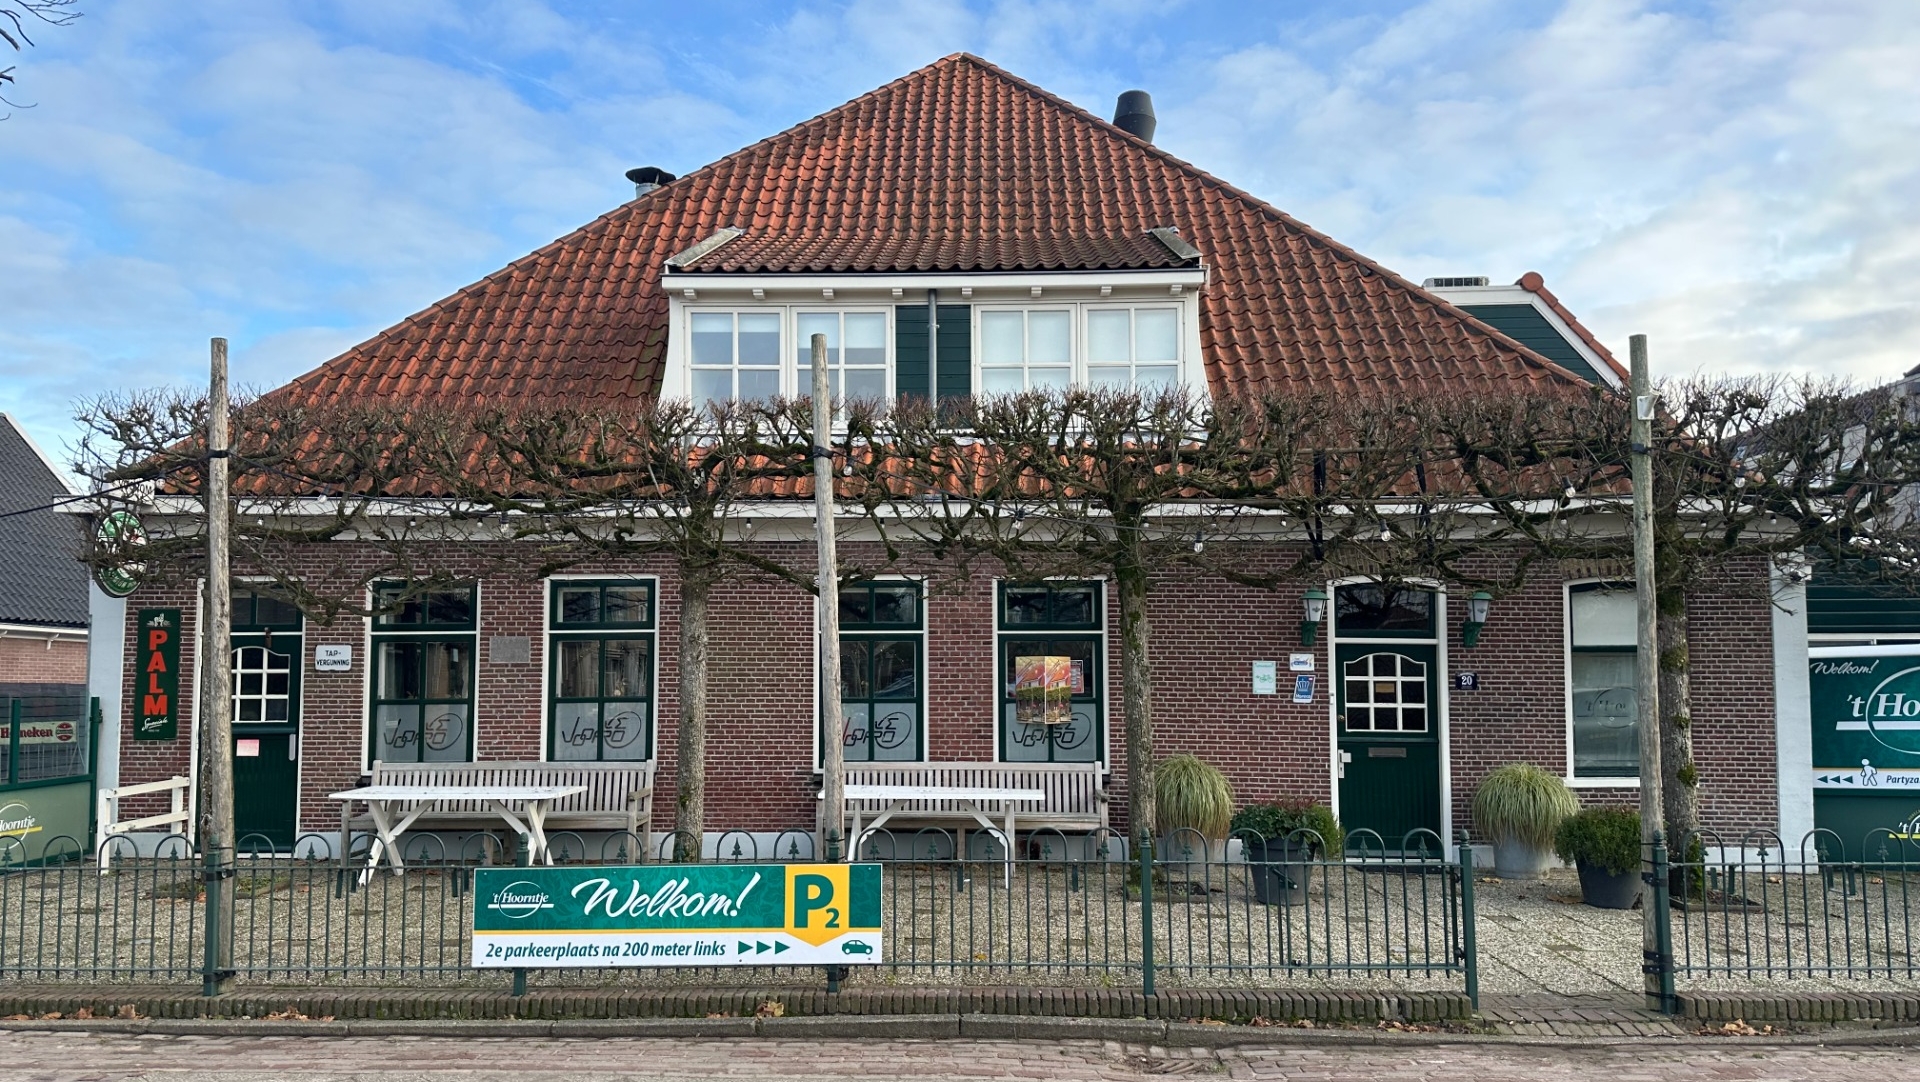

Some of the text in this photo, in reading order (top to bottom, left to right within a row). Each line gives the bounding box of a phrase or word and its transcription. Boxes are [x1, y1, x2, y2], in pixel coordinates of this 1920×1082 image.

[143, 629, 168, 716] PALM
[1810, 659, 1880, 675] Welkom!
[1461, 675, 1473, 686] 20
[501, 891, 549, 905] Hoorntje
[571, 872, 761, 918] Welkom!
[486, 940, 726, 961] 2e parkeerplaats na 200 meter links
